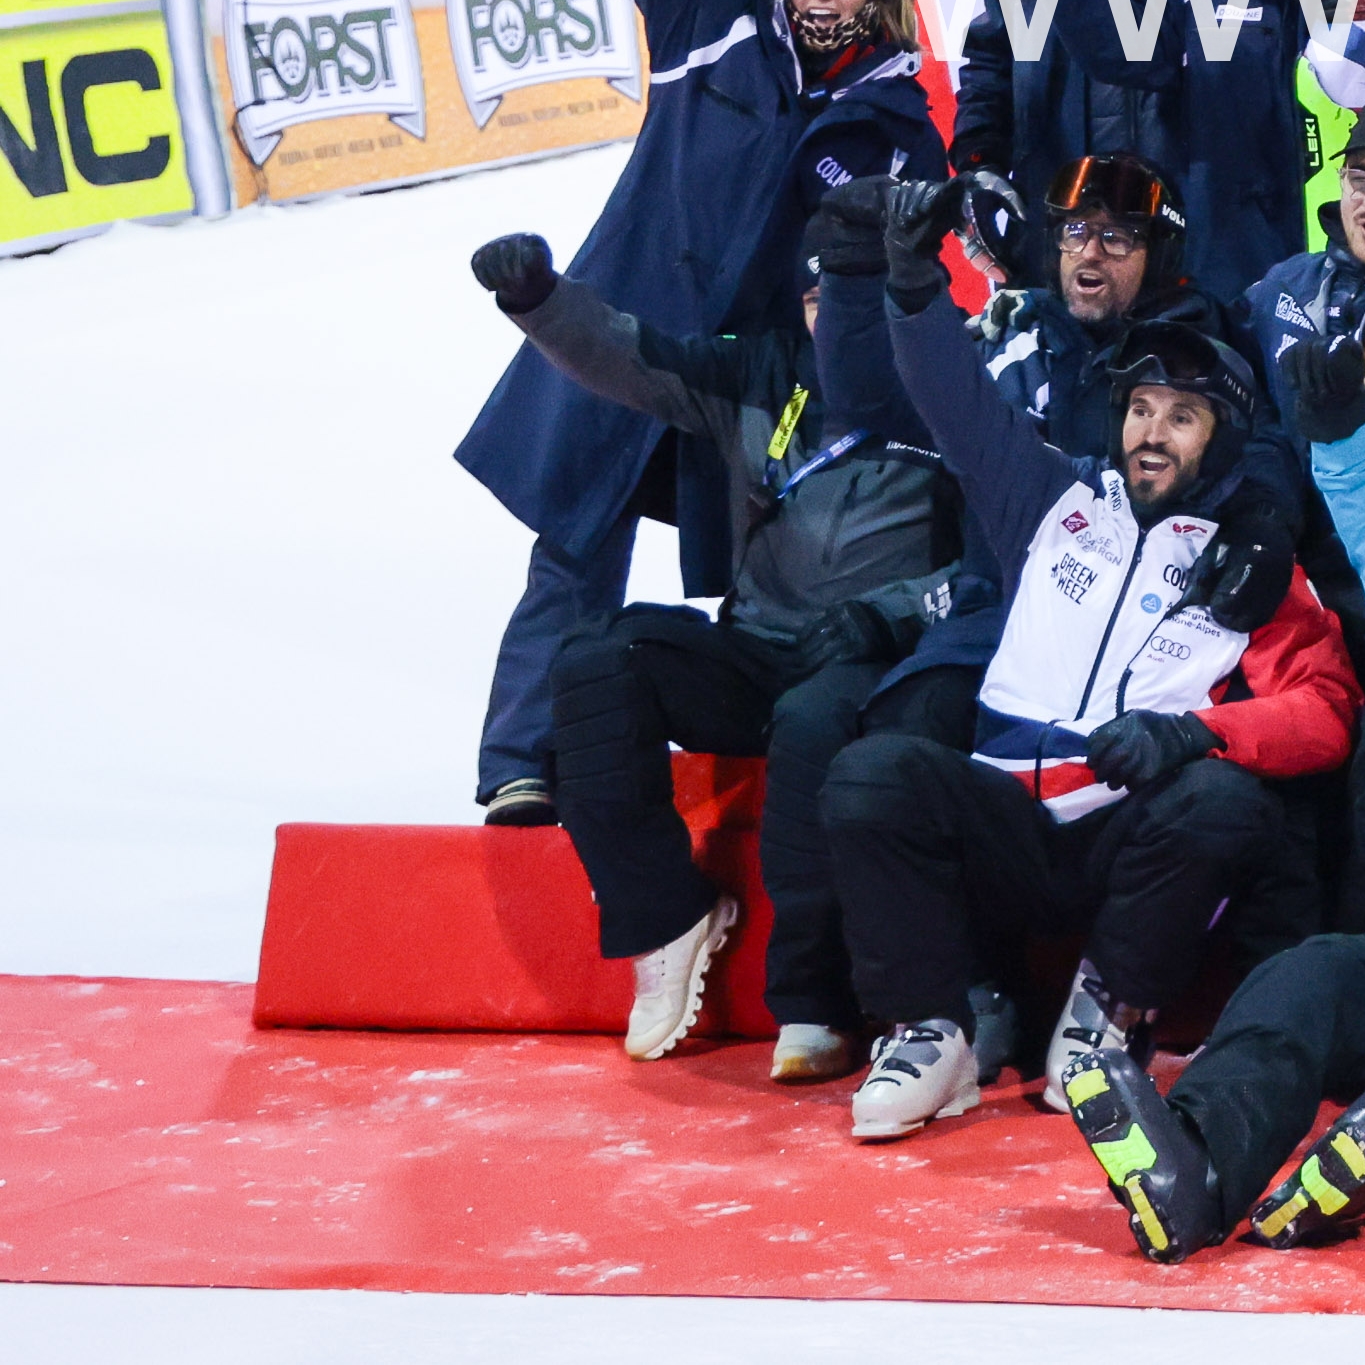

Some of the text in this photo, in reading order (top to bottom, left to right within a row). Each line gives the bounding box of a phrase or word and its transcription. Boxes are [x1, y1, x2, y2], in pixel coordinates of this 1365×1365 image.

[245, 4, 401, 102] FORST
[1305, 118, 1320, 167] LEKI
[816, 156, 853, 188] COLM
[1108, 478, 1122, 512] COLMAR
[1059, 553, 1099, 588] GREEN
[1055, 575, 1088, 606] WEEZ
